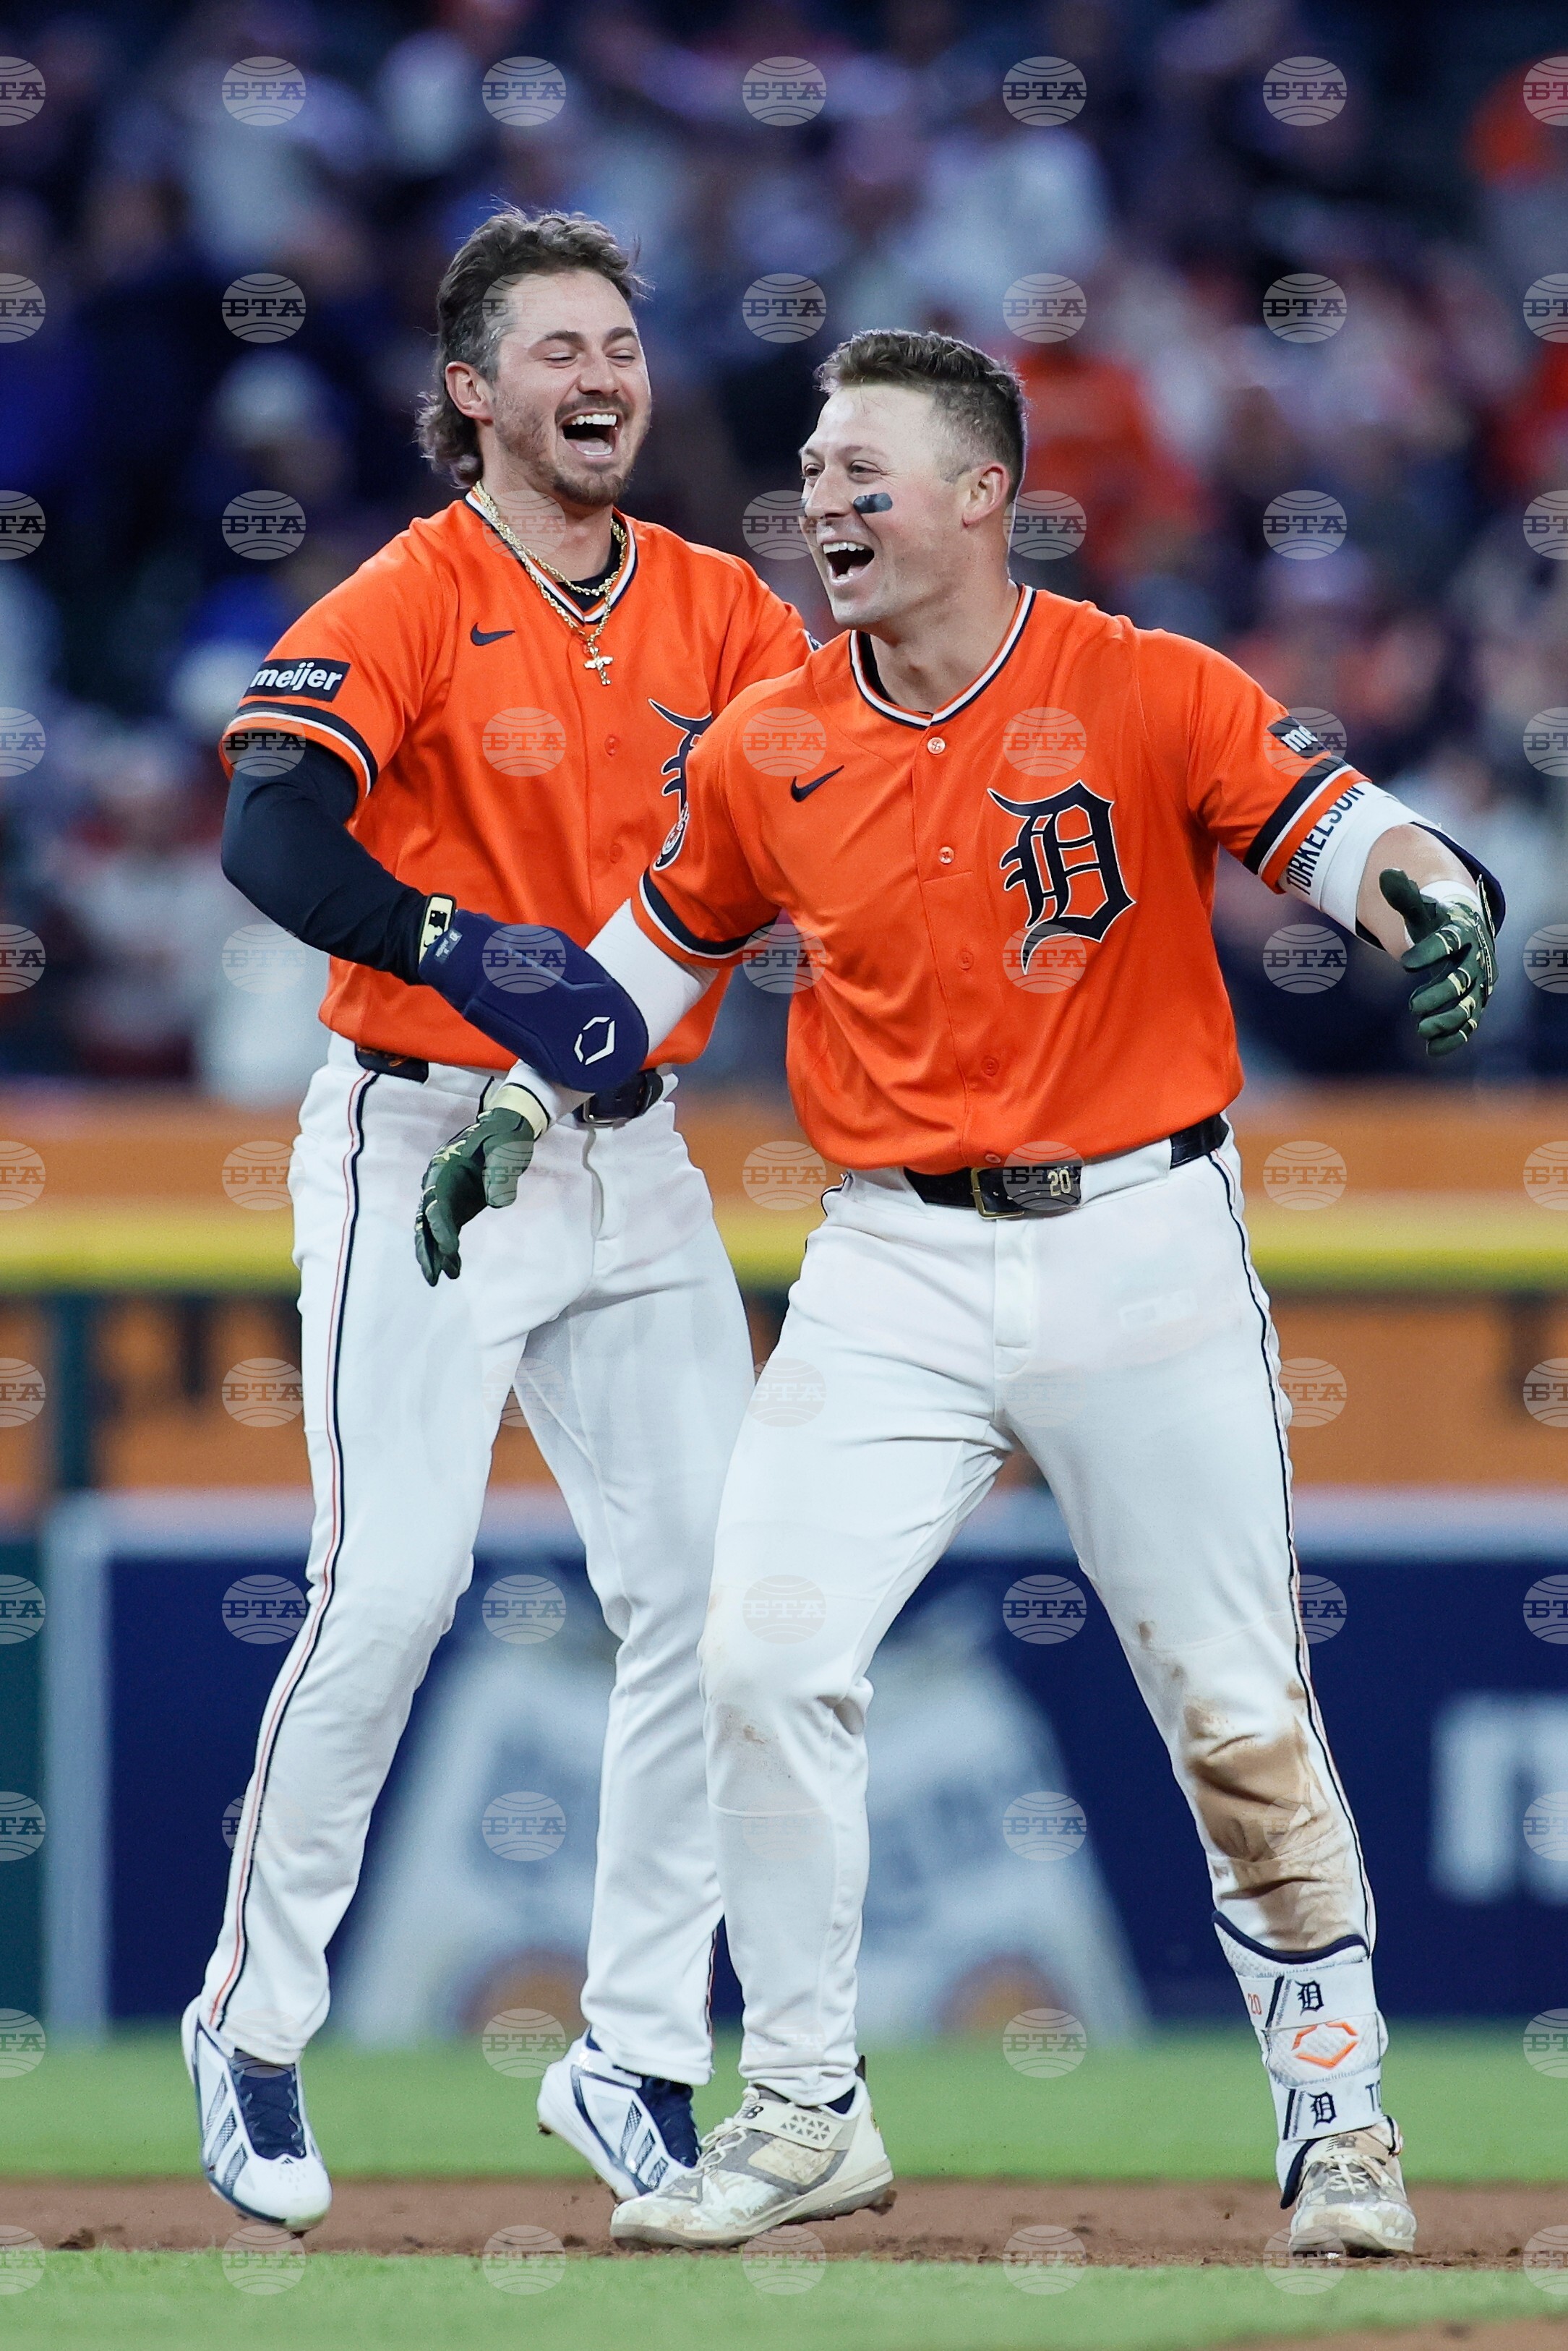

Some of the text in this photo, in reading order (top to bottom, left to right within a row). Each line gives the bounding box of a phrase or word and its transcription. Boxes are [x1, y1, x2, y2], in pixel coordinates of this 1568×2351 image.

[249, 661, 343, 691] meijer
[1285, 785, 1366, 896] TORKELSON
[987, 779, 1137, 976] D
[1048, 1168, 1072, 1196] 20
[1247, 1992, 1262, 2016] 20
